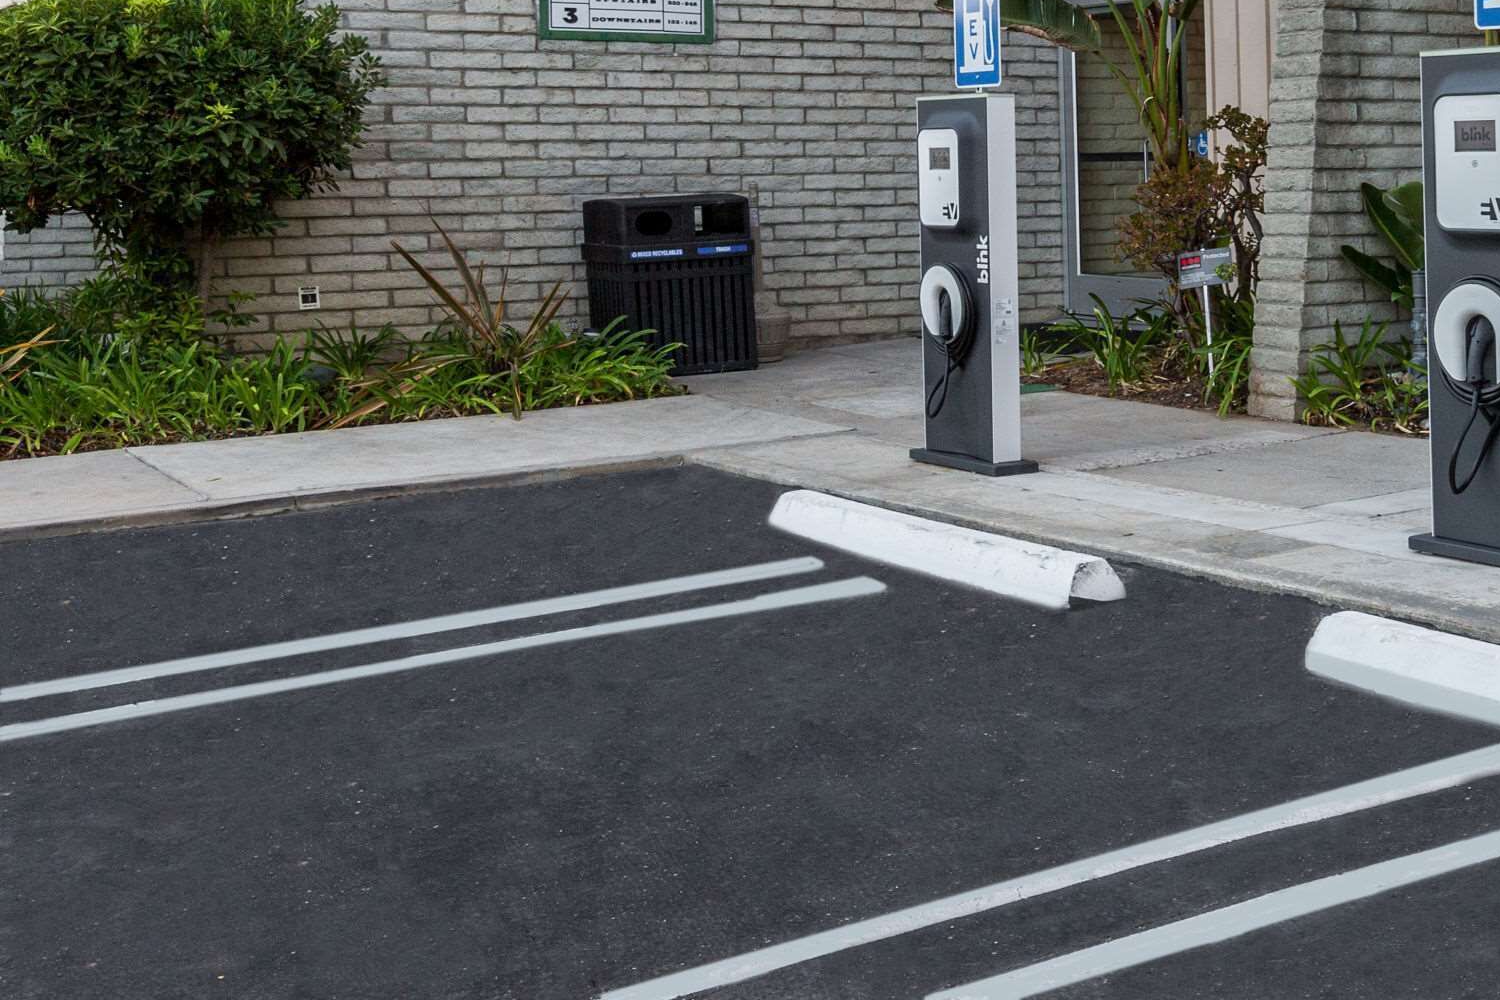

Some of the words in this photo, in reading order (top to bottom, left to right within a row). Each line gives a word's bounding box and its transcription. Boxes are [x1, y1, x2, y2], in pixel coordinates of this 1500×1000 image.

[562, 7, 579, 24] 3
[591, 16, 662, 24] DOWNSTAIRS
[1460, 126, 1491, 142] blink
[976, 235, 989, 284] blink
